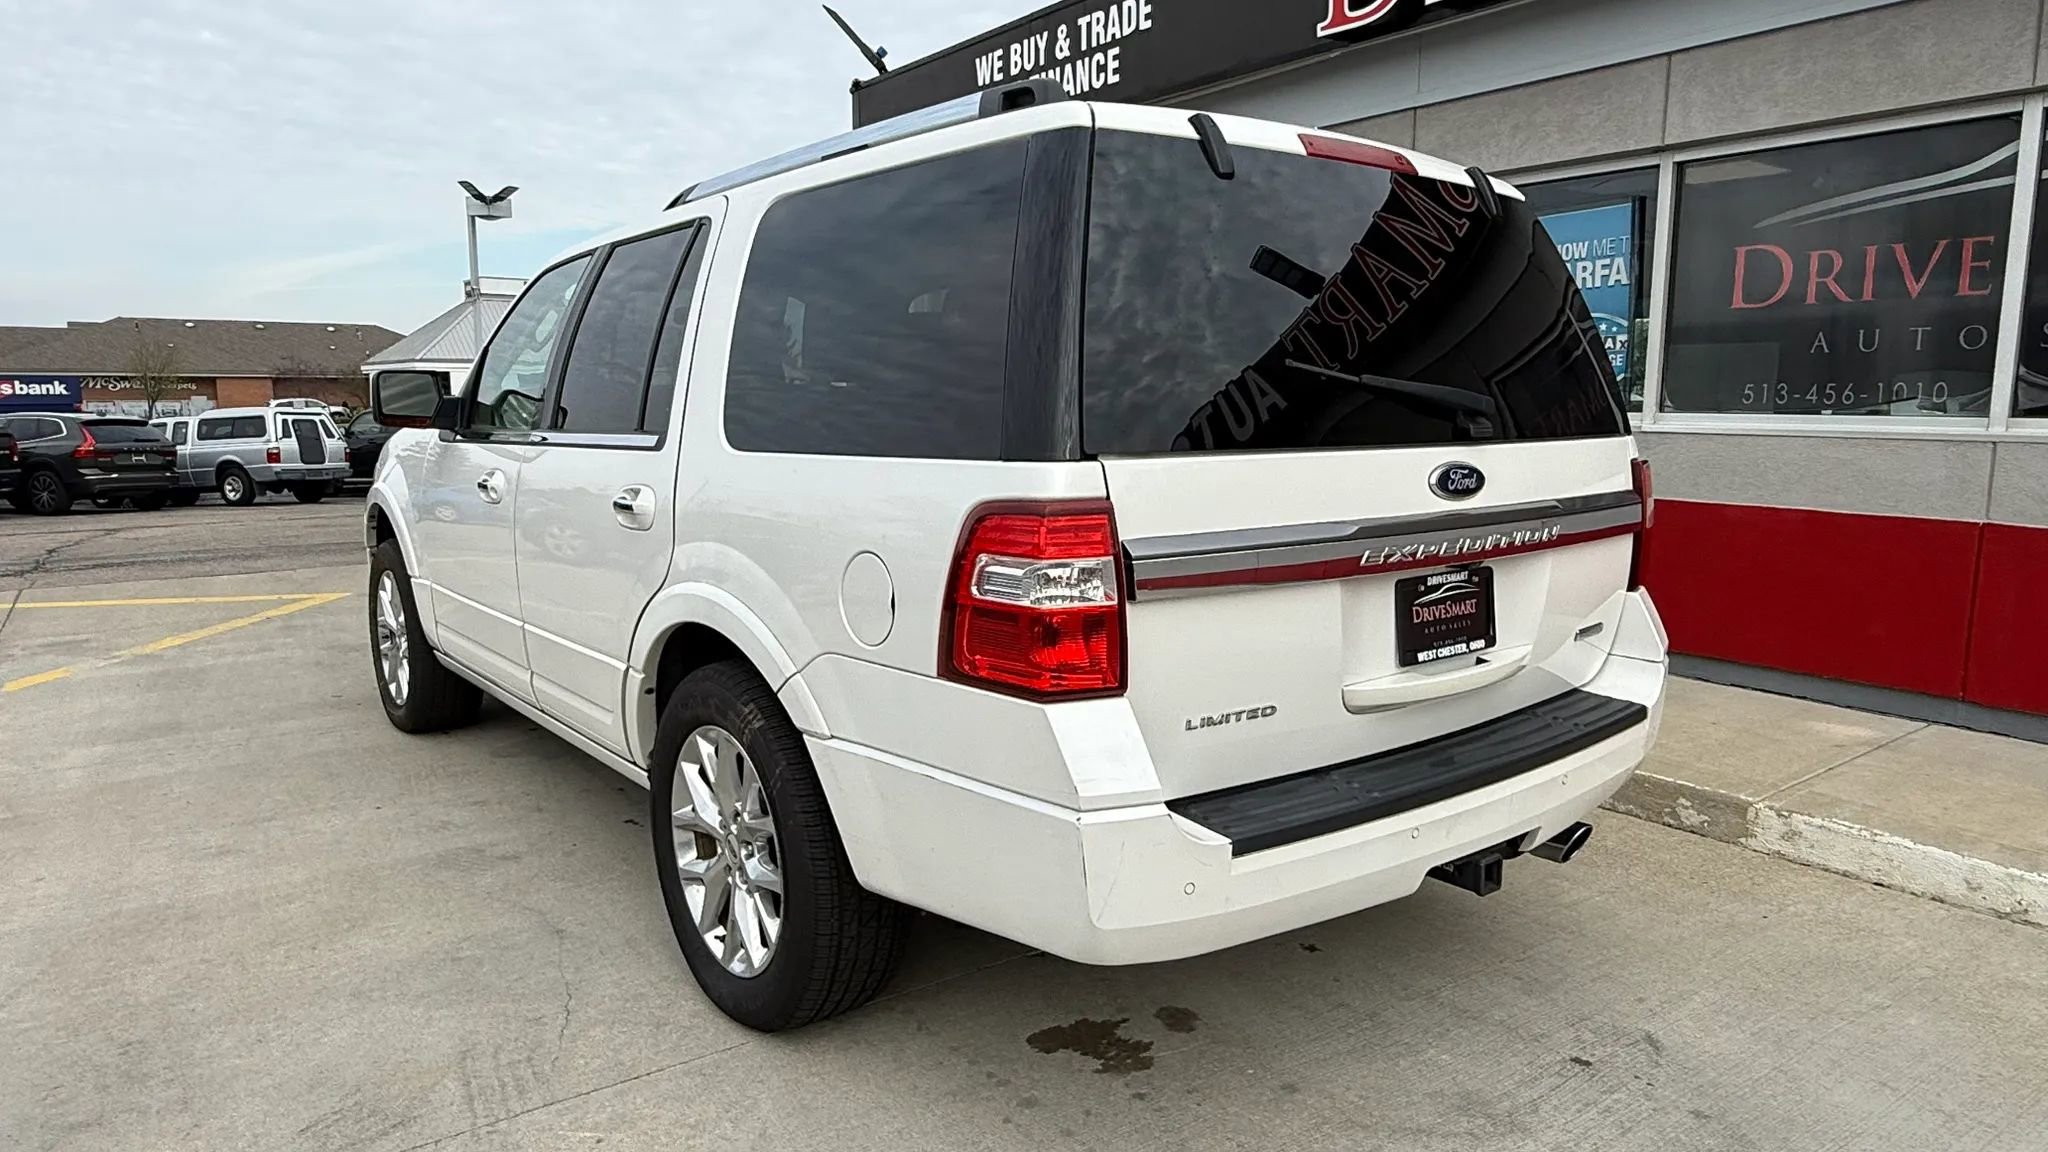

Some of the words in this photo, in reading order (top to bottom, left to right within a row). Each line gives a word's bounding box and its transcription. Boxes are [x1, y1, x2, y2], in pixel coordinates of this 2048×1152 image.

[975, 48, 1003, 87] WE
[1010, 31, 1048, 76] BUY
[1055, 24, 1071, 60] &
[1077, 0, 1152, 51] TRADE
[1029, 46, 1120, 96] ANCE
[1558, 241, 1588, 261] OW
[1593, 237, 1616, 257] ME
[1567, 257, 1631, 289] RFA
[1728, 235, 1995, 310] DRIVE
[1810, 325, 1988, 354] AUTO
[1742, 380, 1949, 406] 513-456-1010
[1448, 468, 1478, 490] Ford
[1359, 524, 1561, 566] EXPEDITION
[1427, 571, 1469, 585] DRIVESMART
[1417, 648, 1437, 662] WEST
[1184, 705, 1278, 731] LIMITED
